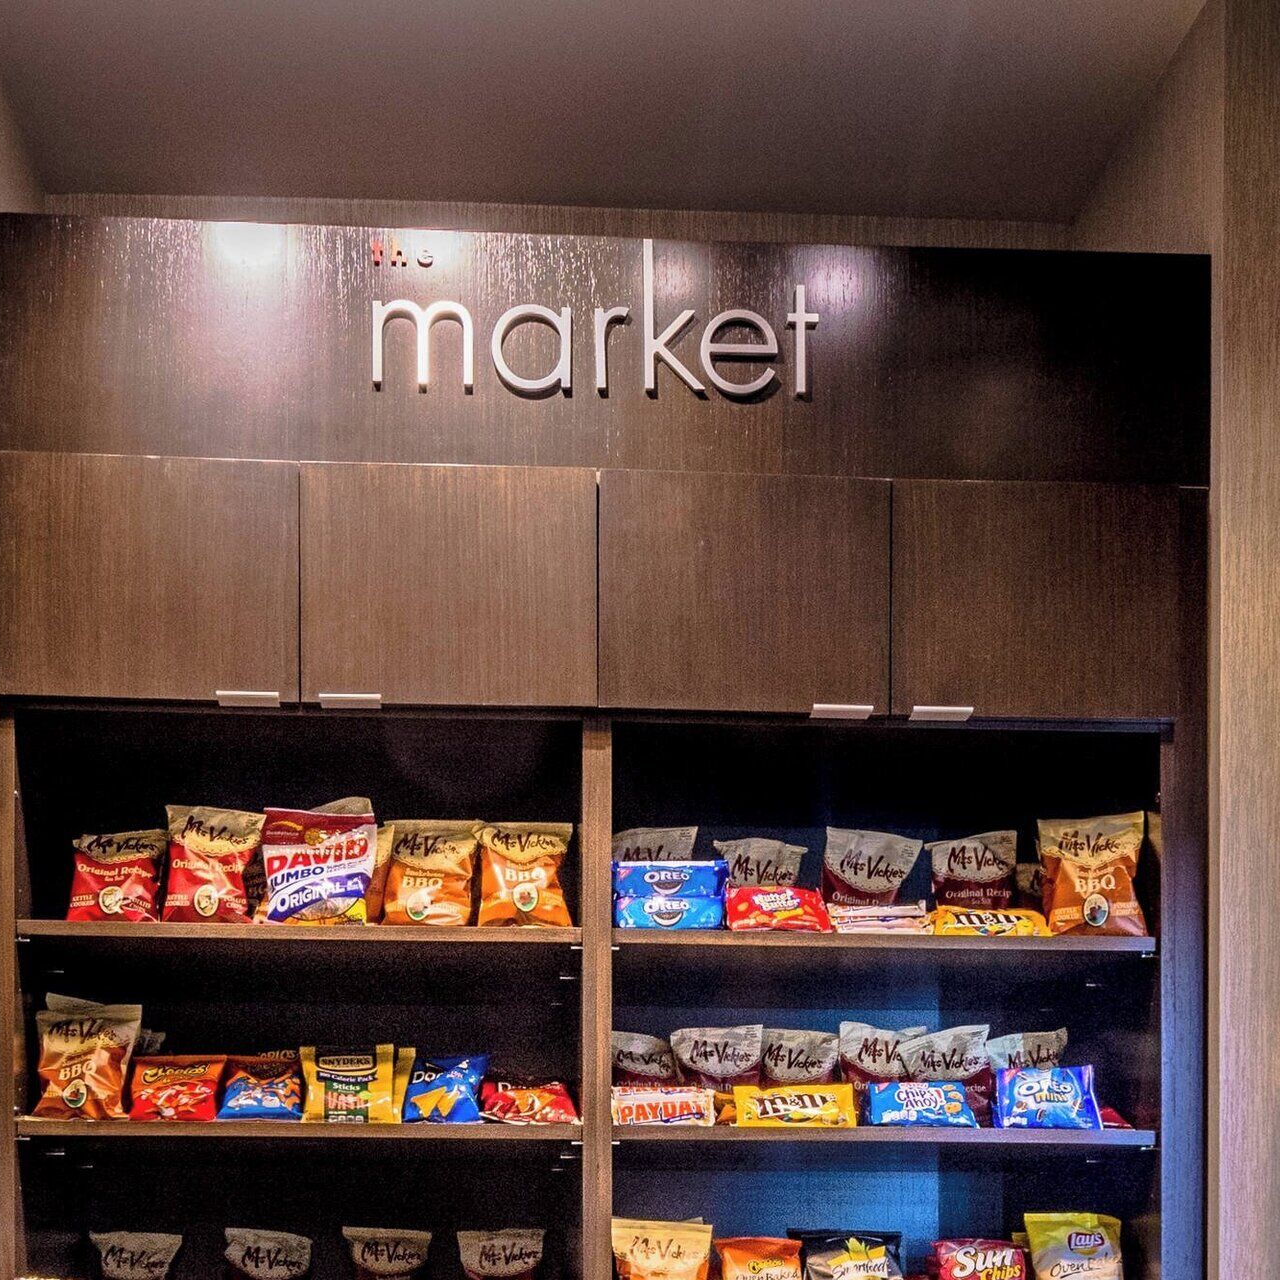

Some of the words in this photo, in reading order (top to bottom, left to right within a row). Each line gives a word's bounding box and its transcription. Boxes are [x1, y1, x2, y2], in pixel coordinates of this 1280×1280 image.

[372, 239, 818, 397] market
[267, 839, 370, 876] DAVID
[271, 866, 324, 891] JUMBO
[504, 868, 546, 883] BBQ
[644, 870, 691, 884] OREO
[402, 877, 442, 890] BBQ
[1074, 876, 1116, 894] BBQ
[945, 888, 983, 899] Original
[644, 899, 691, 912] OREO
[58, 1060, 96, 1081] BBQ
[332, 1083, 361, 1091] Sticks
[898, 1088, 934, 1103] Chips
[620, 1100, 704, 1124] PAYDAY
[953, 1246, 1015, 1279] Sun
[1050, 1262, 1087, 1277] Oven
